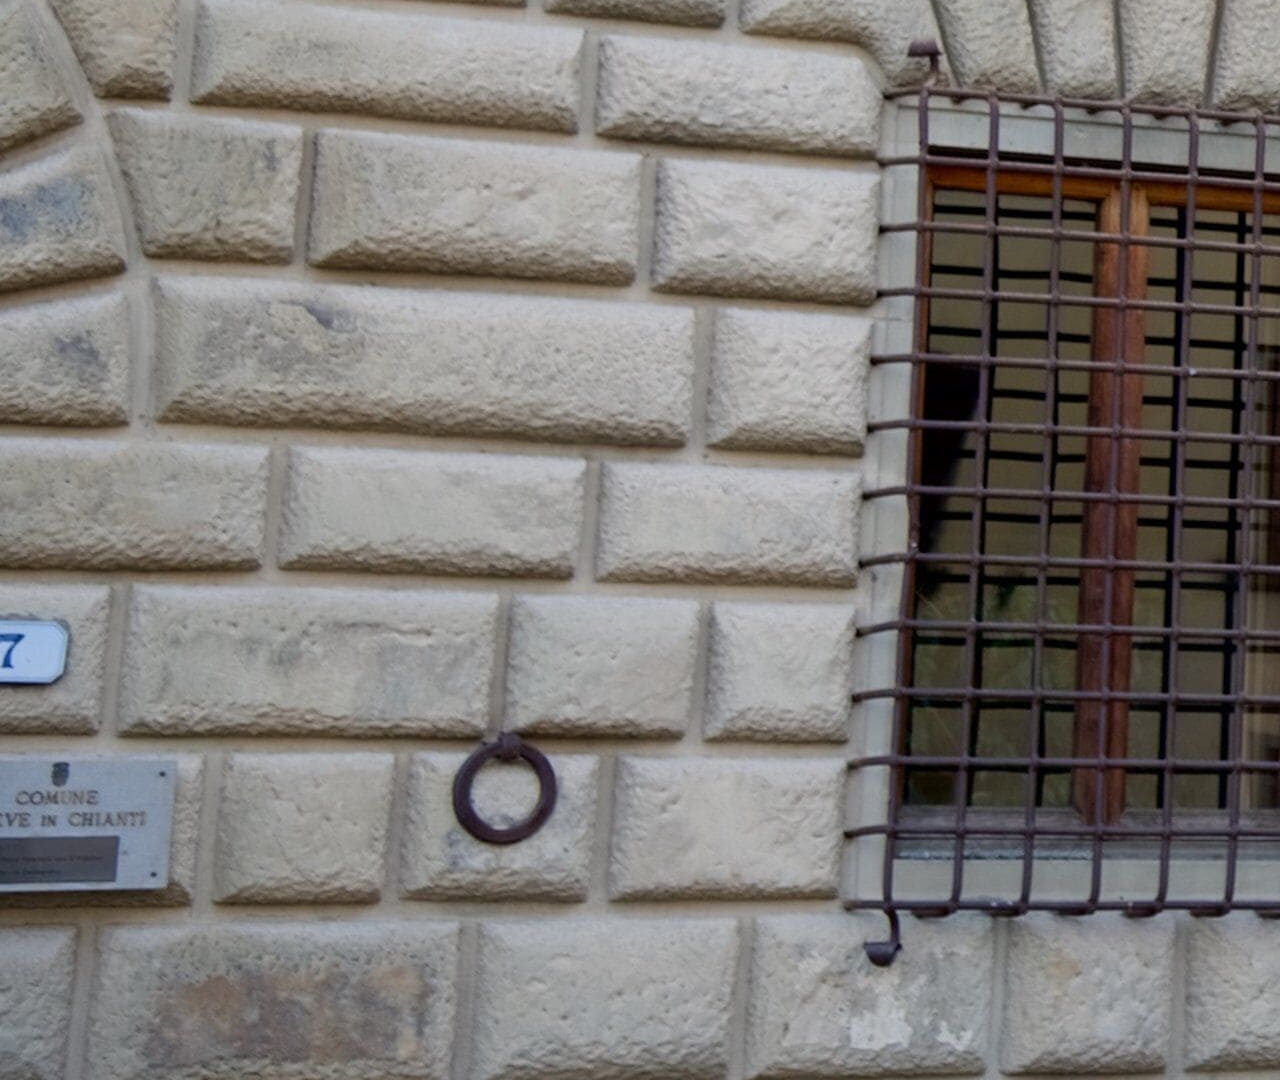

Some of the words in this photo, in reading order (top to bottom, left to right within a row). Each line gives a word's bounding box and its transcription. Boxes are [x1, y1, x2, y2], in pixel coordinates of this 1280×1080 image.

[15, 790, 99, 806] COMUNE
[0, 812, 31, 828] VE
[41, 814, 57, 827] IN
[68, 811, 146, 827] CHIANTI
